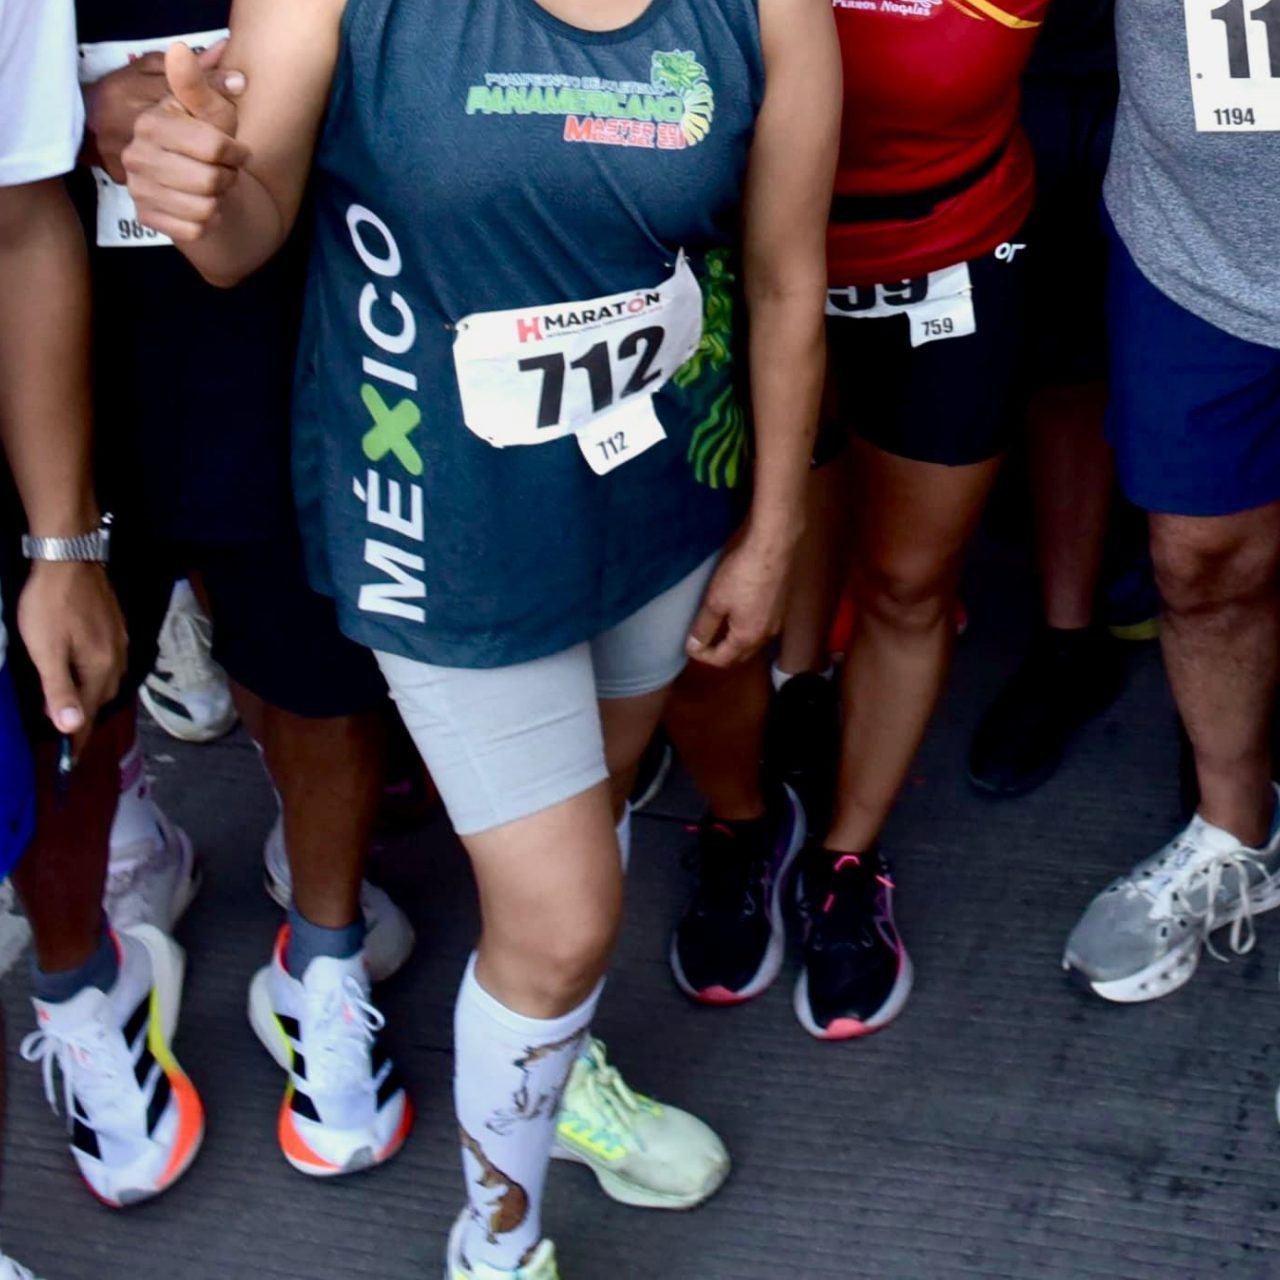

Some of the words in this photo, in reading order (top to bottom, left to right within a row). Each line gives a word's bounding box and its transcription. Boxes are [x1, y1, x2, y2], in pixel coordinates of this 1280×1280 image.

[1213, 107, 1255, 126] 1194
[921, 317, 954, 337] 759
[518, 325, 665, 429] 712
[346, 203, 427, 624] MÉXICO
[596, 430, 629, 460] 712
